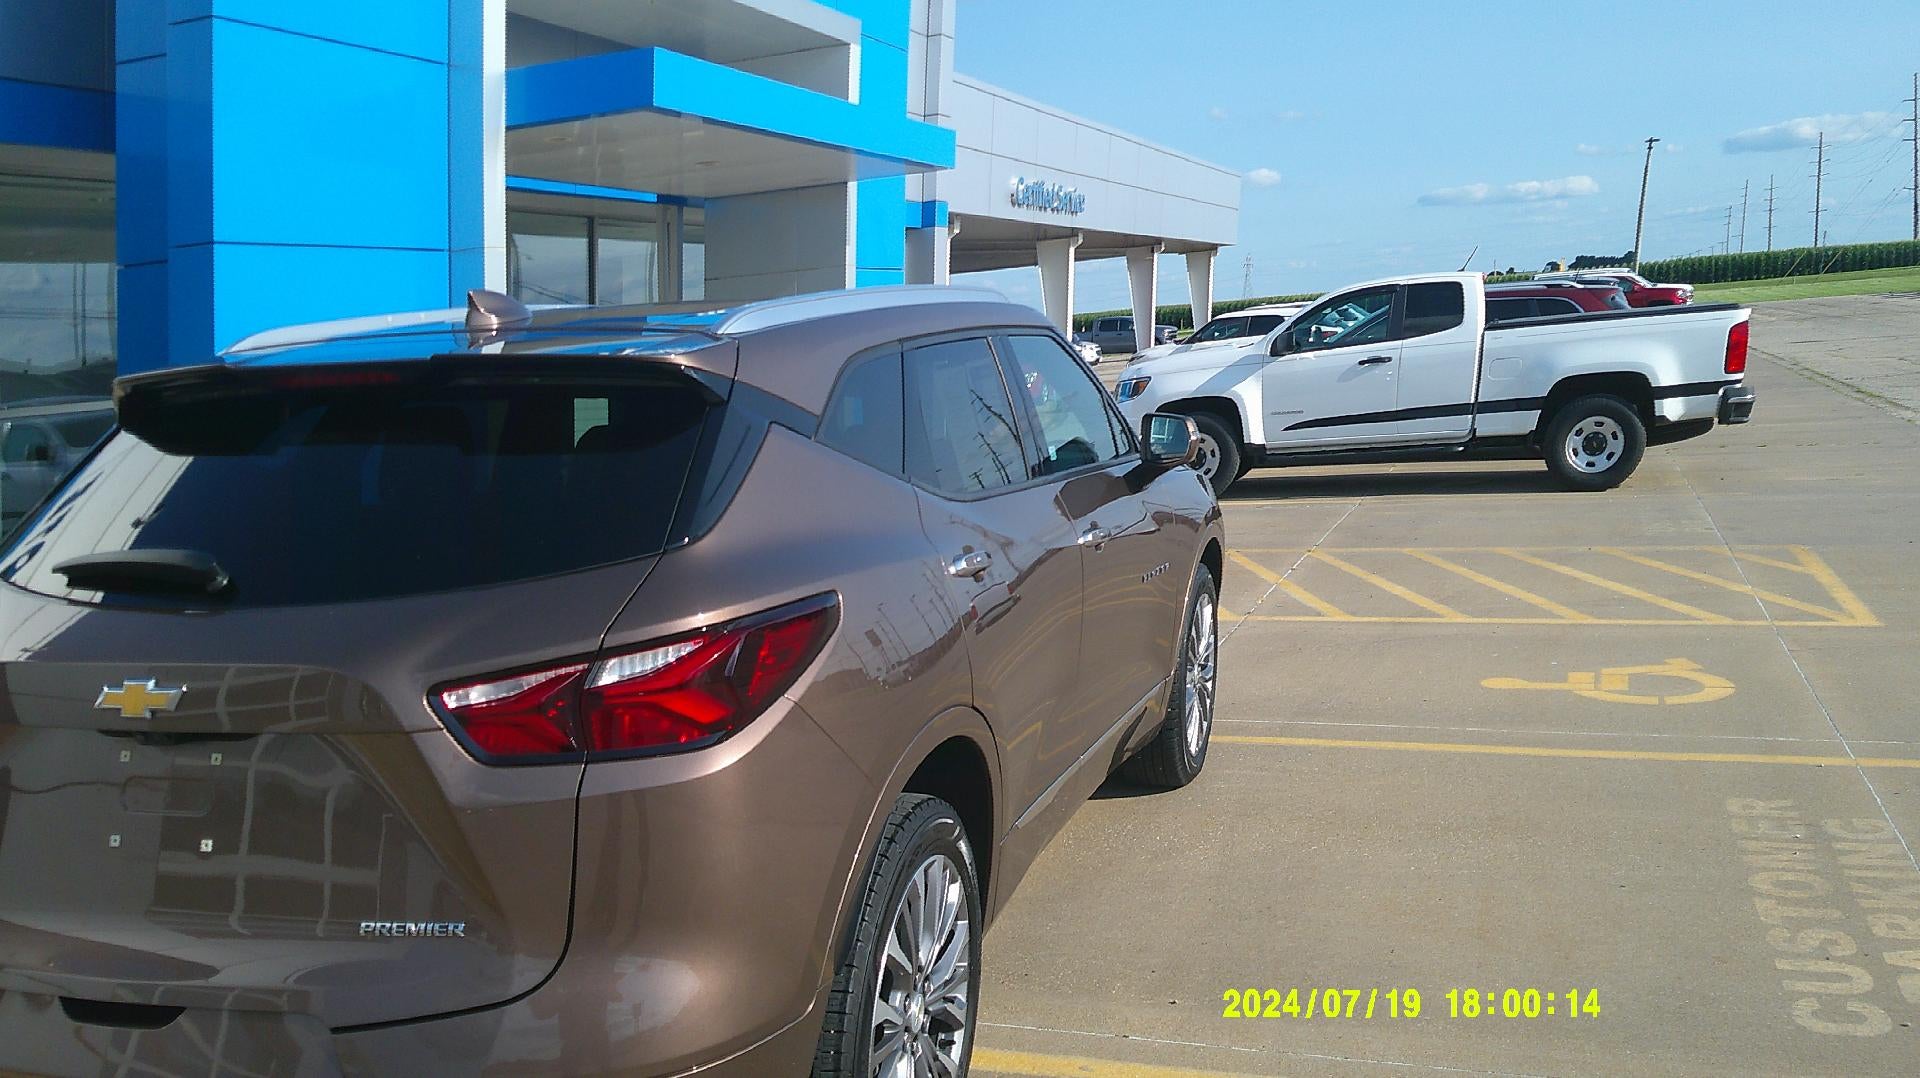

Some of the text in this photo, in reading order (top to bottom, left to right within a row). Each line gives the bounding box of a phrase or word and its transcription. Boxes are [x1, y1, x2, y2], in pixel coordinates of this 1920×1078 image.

[1013, 177, 1086, 215] Certified Service
[359, 921, 466, 938] PREMIER
[1726, 798, 1893, 1037] CUSTOMER
